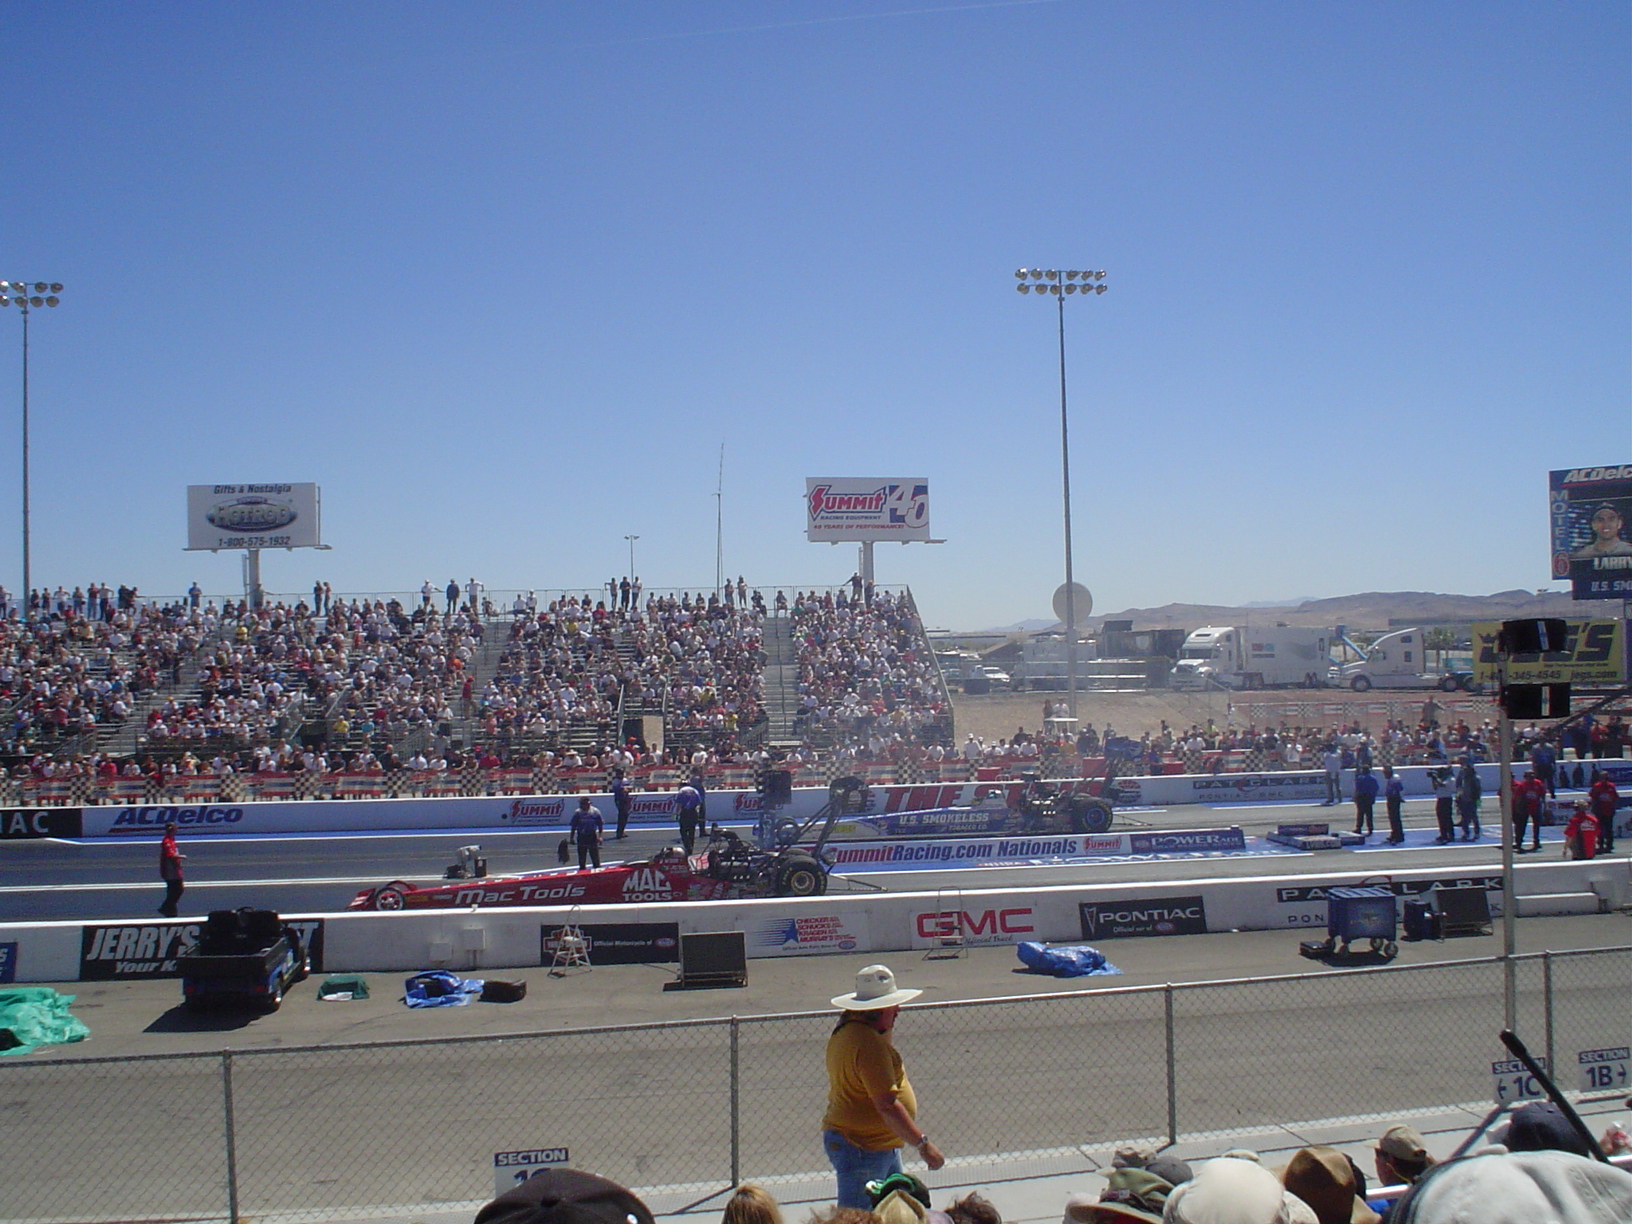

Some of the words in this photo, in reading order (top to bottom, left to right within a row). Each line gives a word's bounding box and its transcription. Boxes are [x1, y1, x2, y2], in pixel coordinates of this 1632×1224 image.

[1564, 465, 1632, 483] ACDelc
[214, 485, 236, 494] Gifts
[239, 485, 244, 494] &
[247, 483, 292, 495] Nostalgia
[1550, 490, 1569, 551] MOTEL
[218, 536, 291, 546] 1-800-575-1932
[1553, 551, 1570, 576] 6
[1613, 580, 1632, 591] SM
[884, 785, 964, 813] THE
[114, 805, 243, 825] ACDelco
[900, 815, 919, 826] U.S.
[922, 812, 989, 825] SMOKELESS
[996, 837, 1077, 857] Nationals
[622, 867, 672, 892] MAC
[455, 888, 515, 905] Mac
[519, 883, 586, 900] Tools
[622, 891, 673, 902] TOOLS
[1281, 887, 1326, 901] PA
[916, 907, 1034, 938] GMC
[1098, 907, 1201, 924] PONTIAC
[86, 925, 200, 960] JERRY'S
[115, 961, 160, 973] Your
[160, 960, 178, 972] K
[1580, 1048, 1630, 1063] SECTION
[1494, 1058, 1544, 1073] SECTN
[1586, 1065, 1613, 1088] 1B
[1513, 1075, 1540, 1098] 1C
[497, 1149, 567, 1166] SECTION
